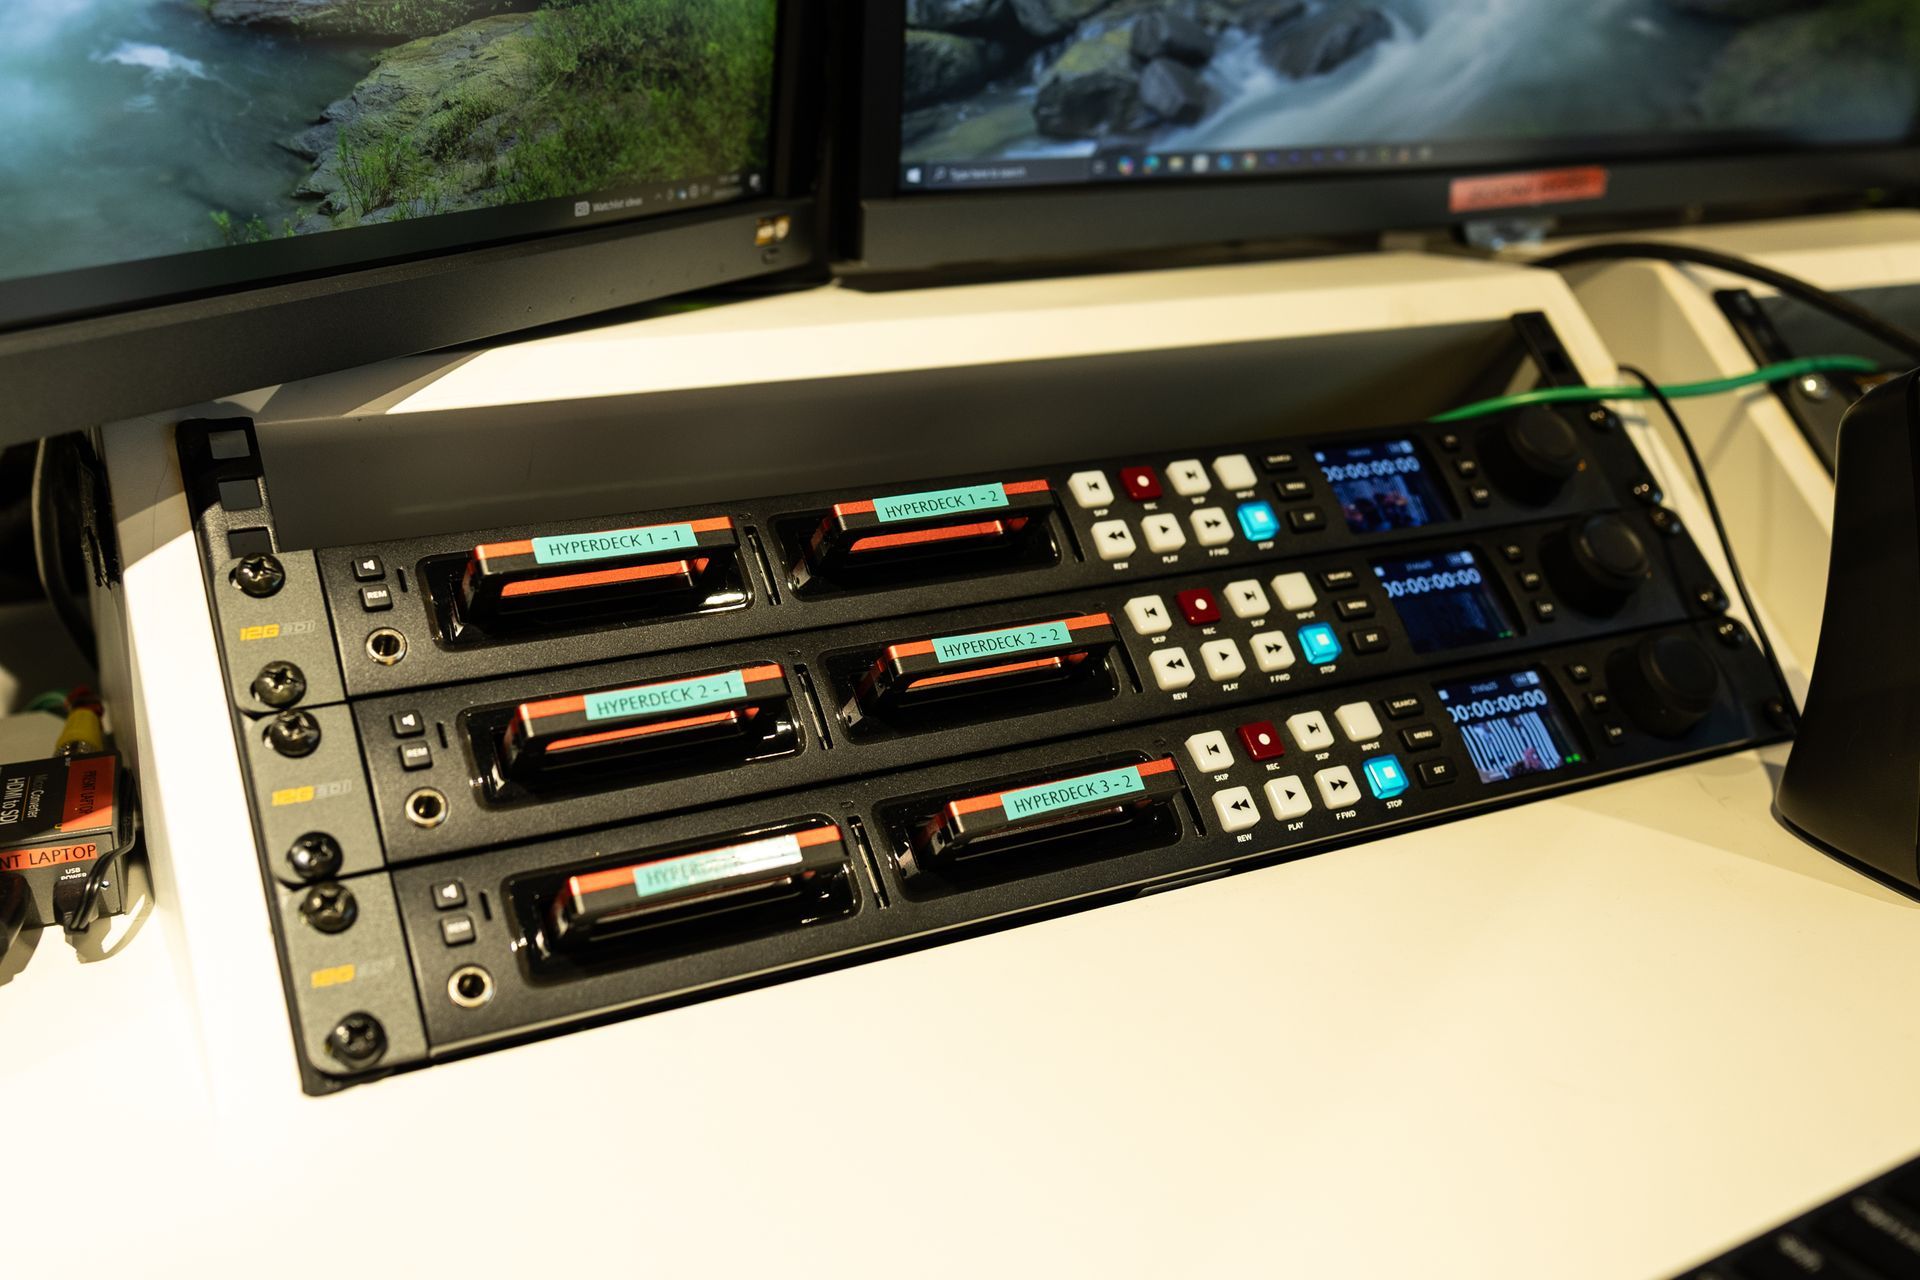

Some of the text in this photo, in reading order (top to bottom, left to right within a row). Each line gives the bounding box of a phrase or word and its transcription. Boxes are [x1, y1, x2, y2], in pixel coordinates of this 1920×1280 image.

[885, 495, 965, 518] HYPERDECK
[968, 494, 975, 504] 1
[989, 490, 999, 502] 2
[549, 534, 642, 556] HYPERDECK
[647, 533, 654, 545] 1
[673, 530, 681, 542] 1
[1327, 571, 1353, 580] SEARCH
[366, 590, 387, 599] REM
[1347, 601, 1367, 610] MENU
[1296, 610, 1316, 620] INPUT
[1251, 619, 1266, 628] SKIP
[240, 623, 280, 641] 12G
[1202, 627, 1217, 635] REC
[943, 633, 1025, 658] HYPERDECK
[1027, 632, 1037, 644] 2
[1050, 628, 1060, 641] 2
[1151, 635, 1167, 644] SKIP
[1366, 633, 1378, 643] SET
[1320, 664, 1337, 674] STOP
[1275, 673, 1290, 682] FWD
[1222, 683, 1239, 692] PLAY
[596, 687, 693, 715] HYPERDECK
[698, 684, 709, 699] 2
[724, 680, 732, 694] 1
[1172, 692, 1188, 701] REW
[1392, 699, 1418, 709] SEARCH
[1413, 730, 1433, 740] MENU
[1361, 741, 1380, 751] INPUT
[1315, 752, 1329, 761] SKIP
[1266, 762, 1280, 771] REC
[1433, 765, 1445, 775] SET
[1214, 773, 1229, 782] SKIP
[1014, 782, 1099, 813] HYPERDECK
[1100, 779, 1110, 793] 3
[1122, 775, 1133, 788] 2
[0, 777, 25, 825] HDMI to SDI
[27, 790, 45, 818] Converter
[1386, 799, 1403, 809] STOP
[1341, 810, 1357, 819] FWD
[1287, 821, 1304, 831] PLAY
[1237, 833, 1252, 843] REW
[29, 844, 97, 865] LAPTOP
